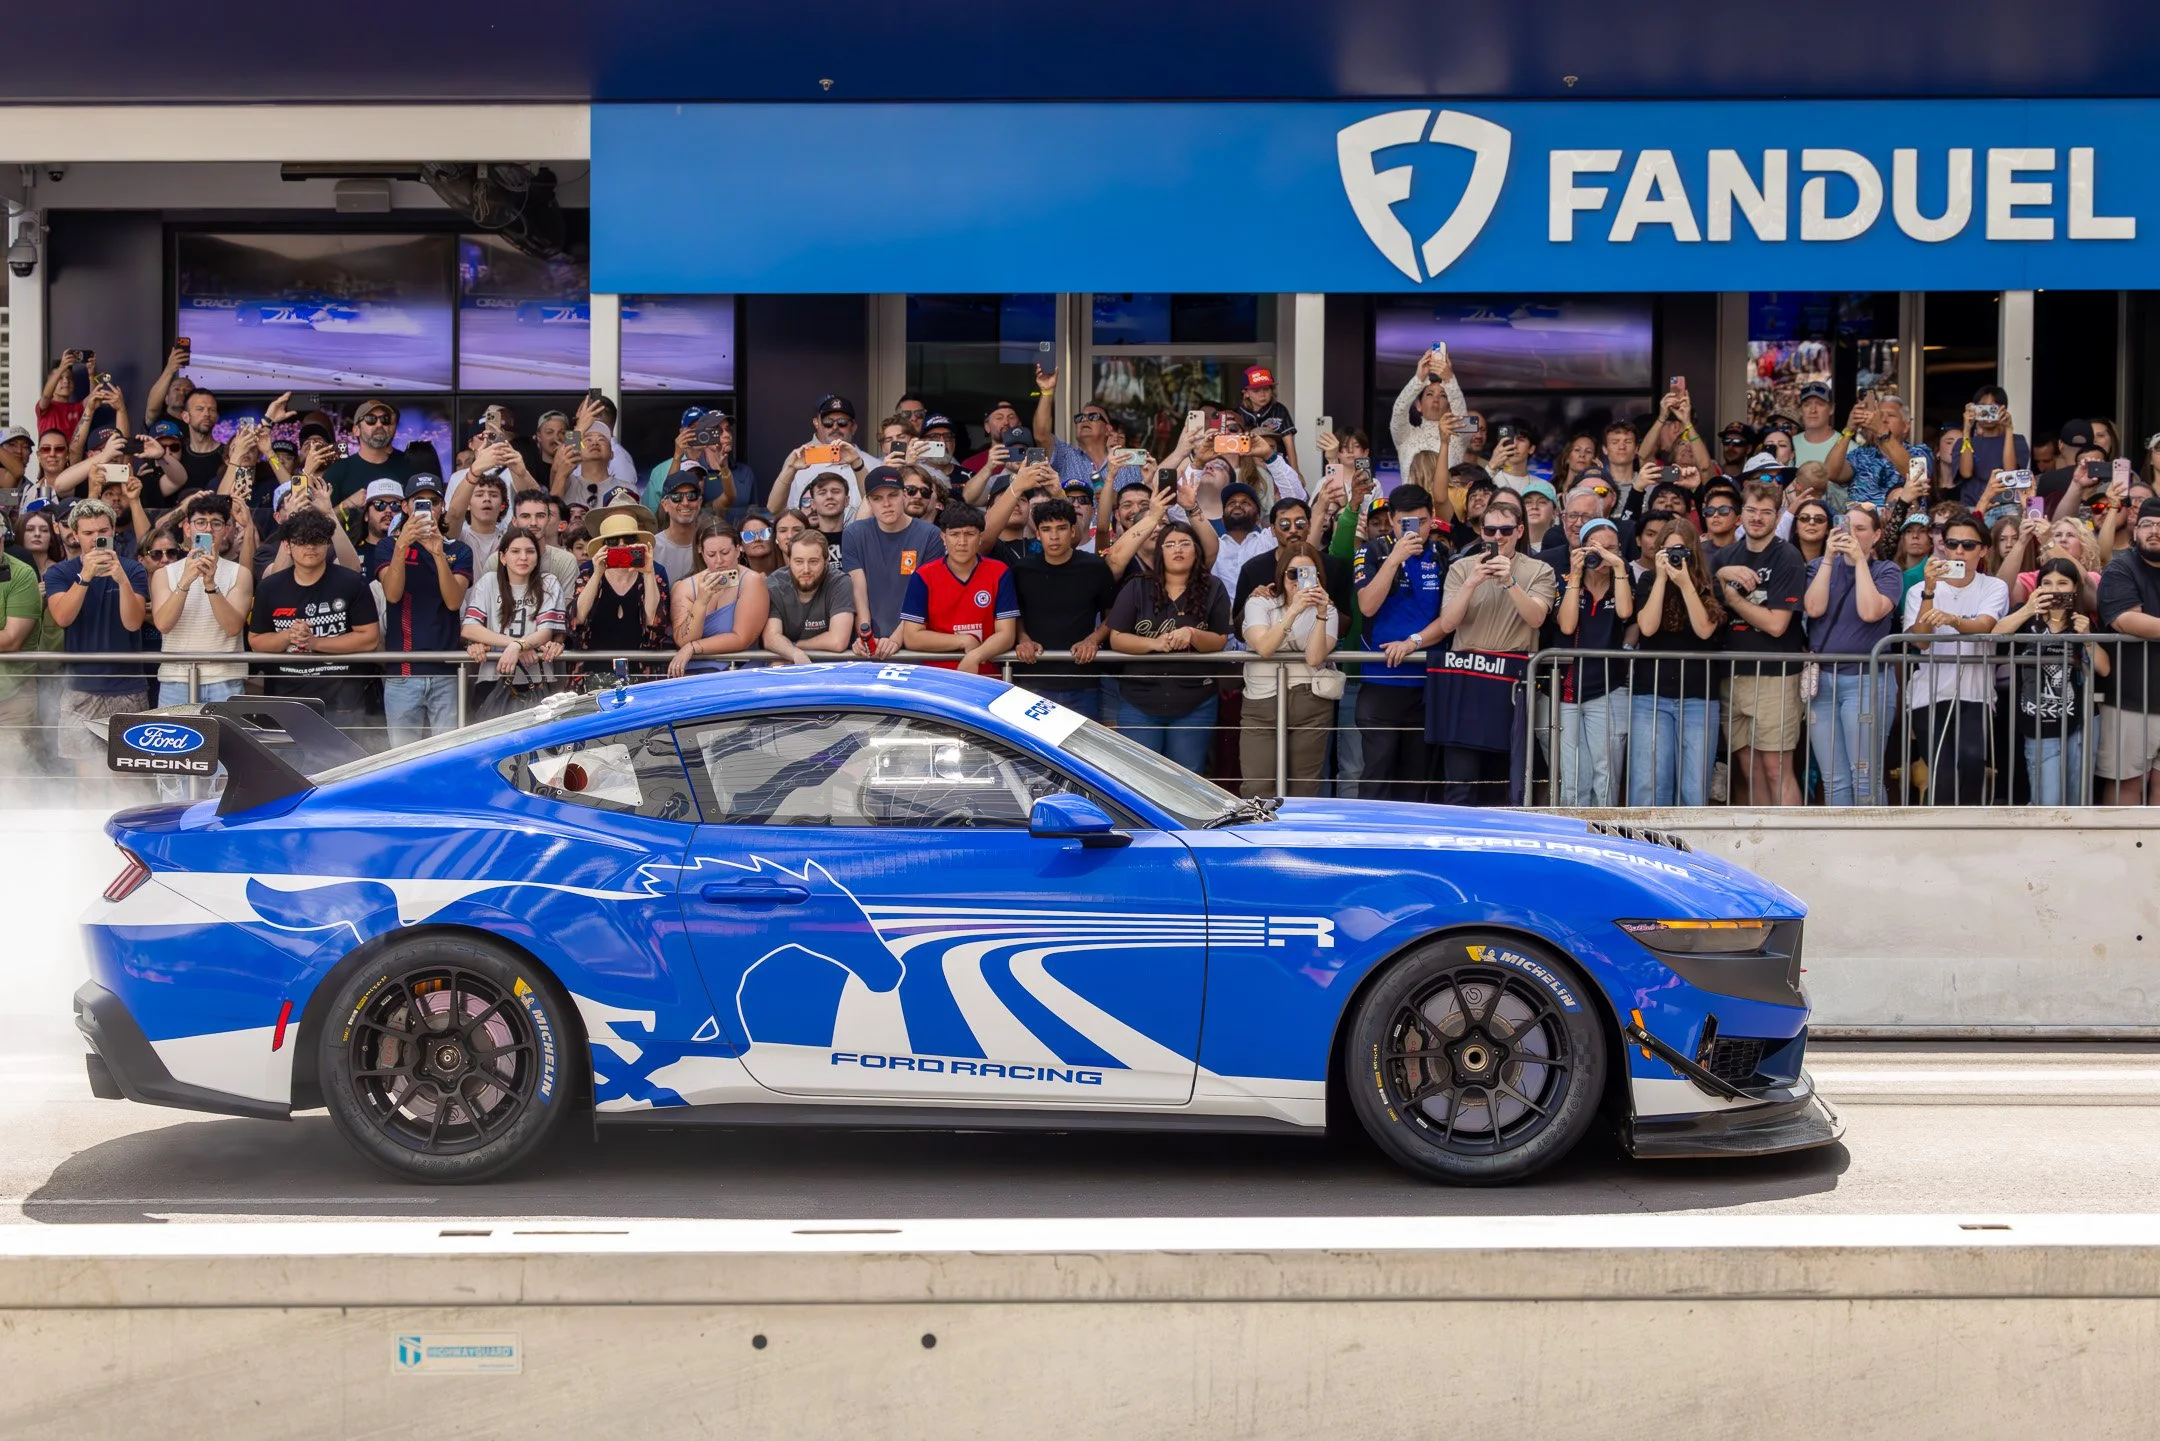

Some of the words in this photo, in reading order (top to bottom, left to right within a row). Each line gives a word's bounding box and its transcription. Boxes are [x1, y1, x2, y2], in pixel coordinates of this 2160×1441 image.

[1549, 147, 2136, 243] FANDUEL
[1445, 651, 1473, 669] Red
[1473, 654, 1506, 675] Bull
[138, 726, 189, 749] Ford
[116, 757, 209, 771] RACING
[1545, 841, 1690, 878] RACING
[1500, 951, 1577, 1008] MICHELIN
[532, 1008, 554, 1098] MICHELIN
[830, 1052, 947, 1073] FORD
[950, 1061, 1103, 1085] RACING
